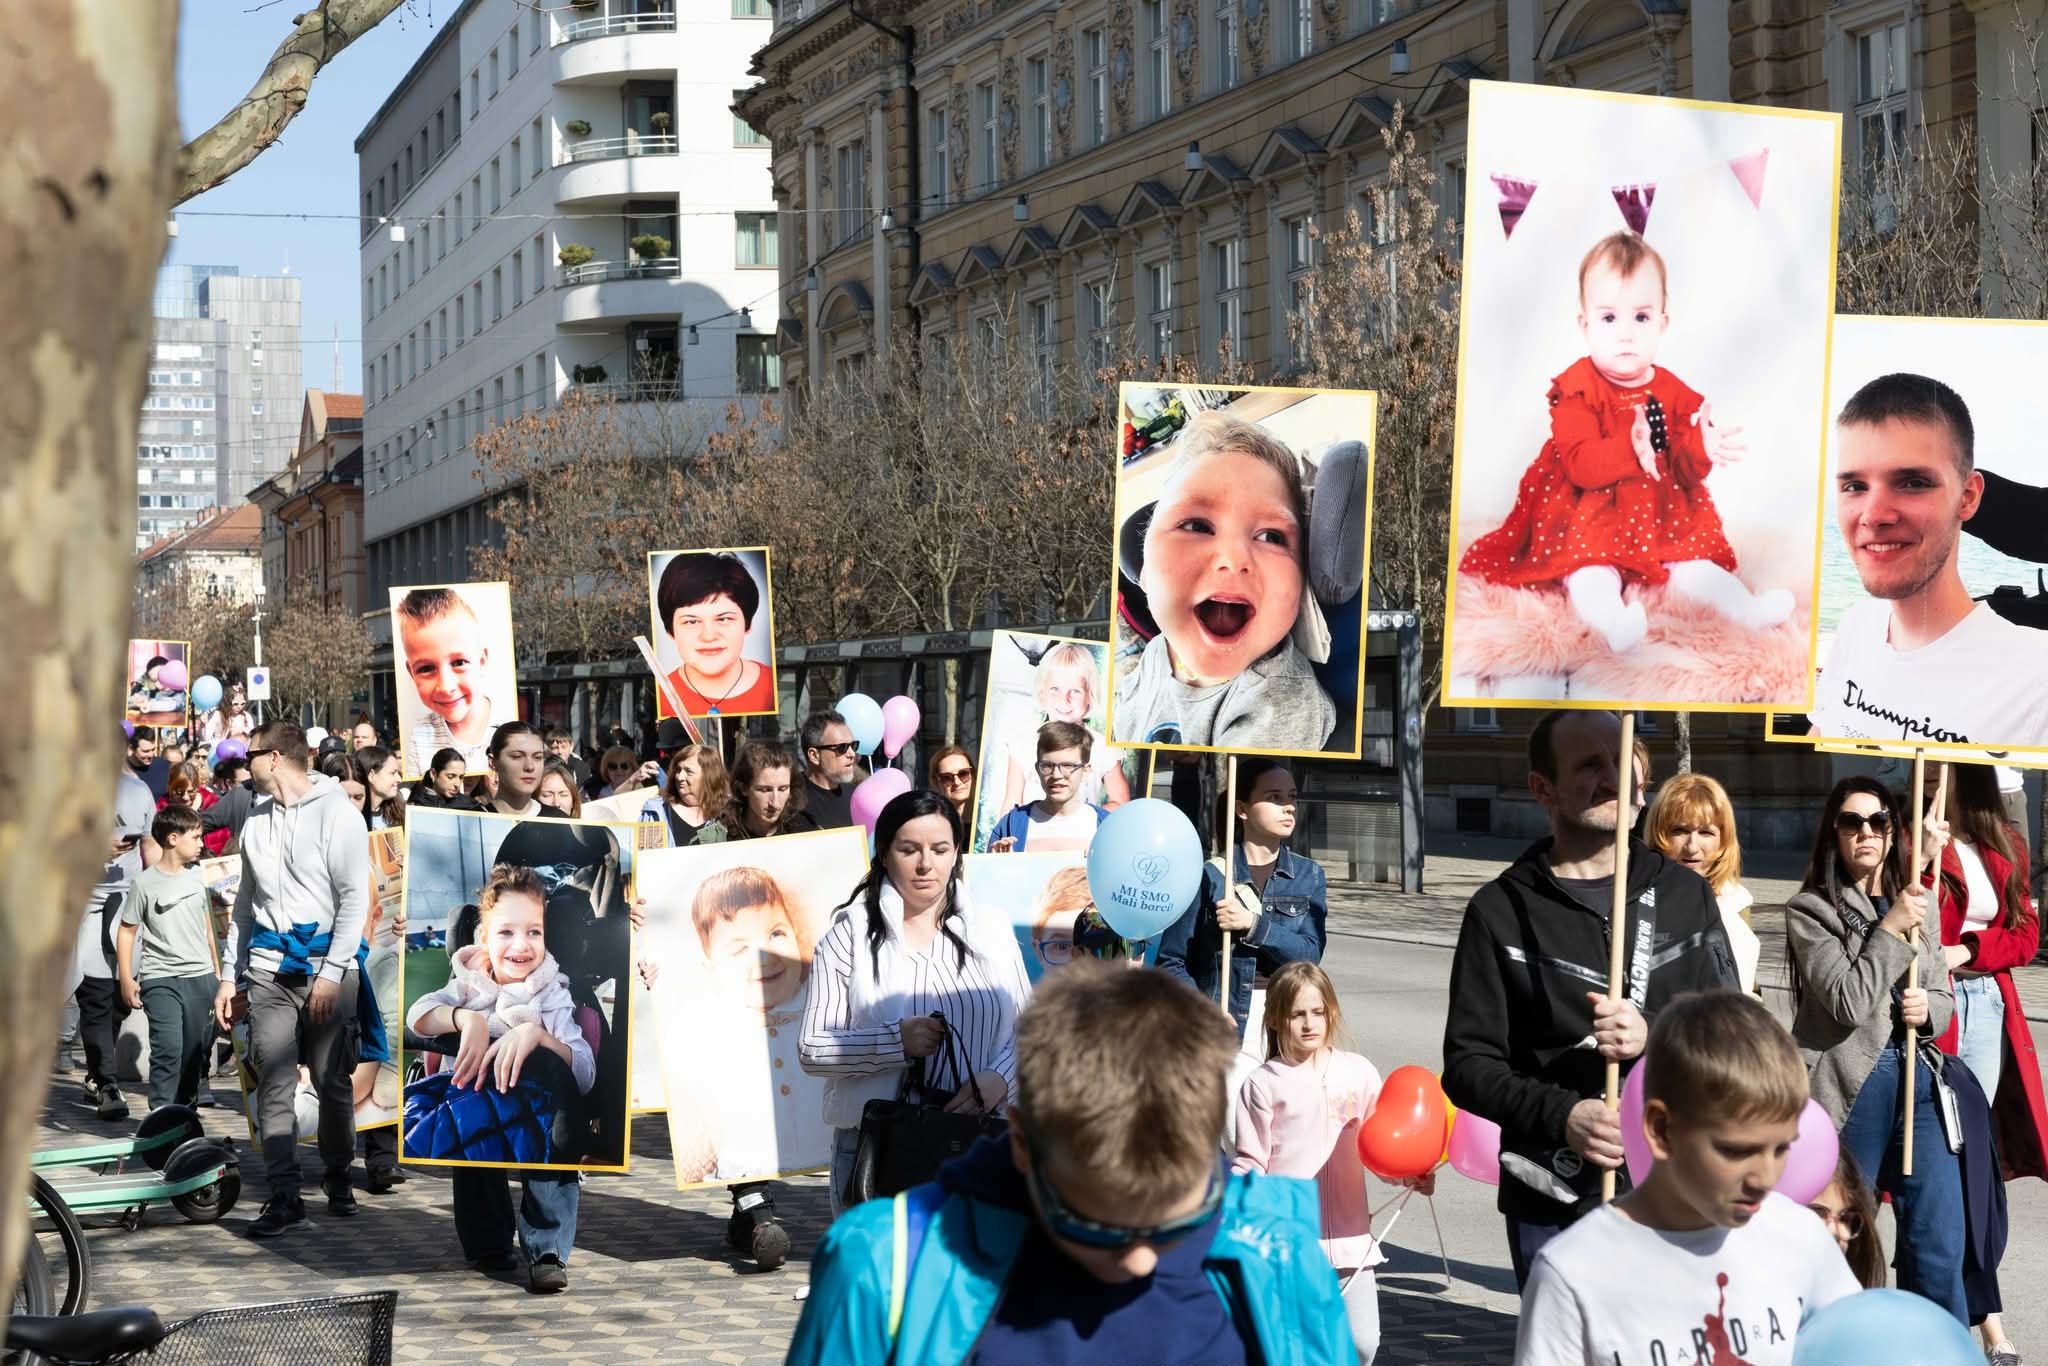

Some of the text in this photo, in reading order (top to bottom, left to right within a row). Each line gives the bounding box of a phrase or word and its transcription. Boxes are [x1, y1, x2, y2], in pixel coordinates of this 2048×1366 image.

[1111, 891, 1138, 908] Mali
[1120, 884, 1171, 903] MI SMO
[1614, 1297, 1804, 1366] ORDA
